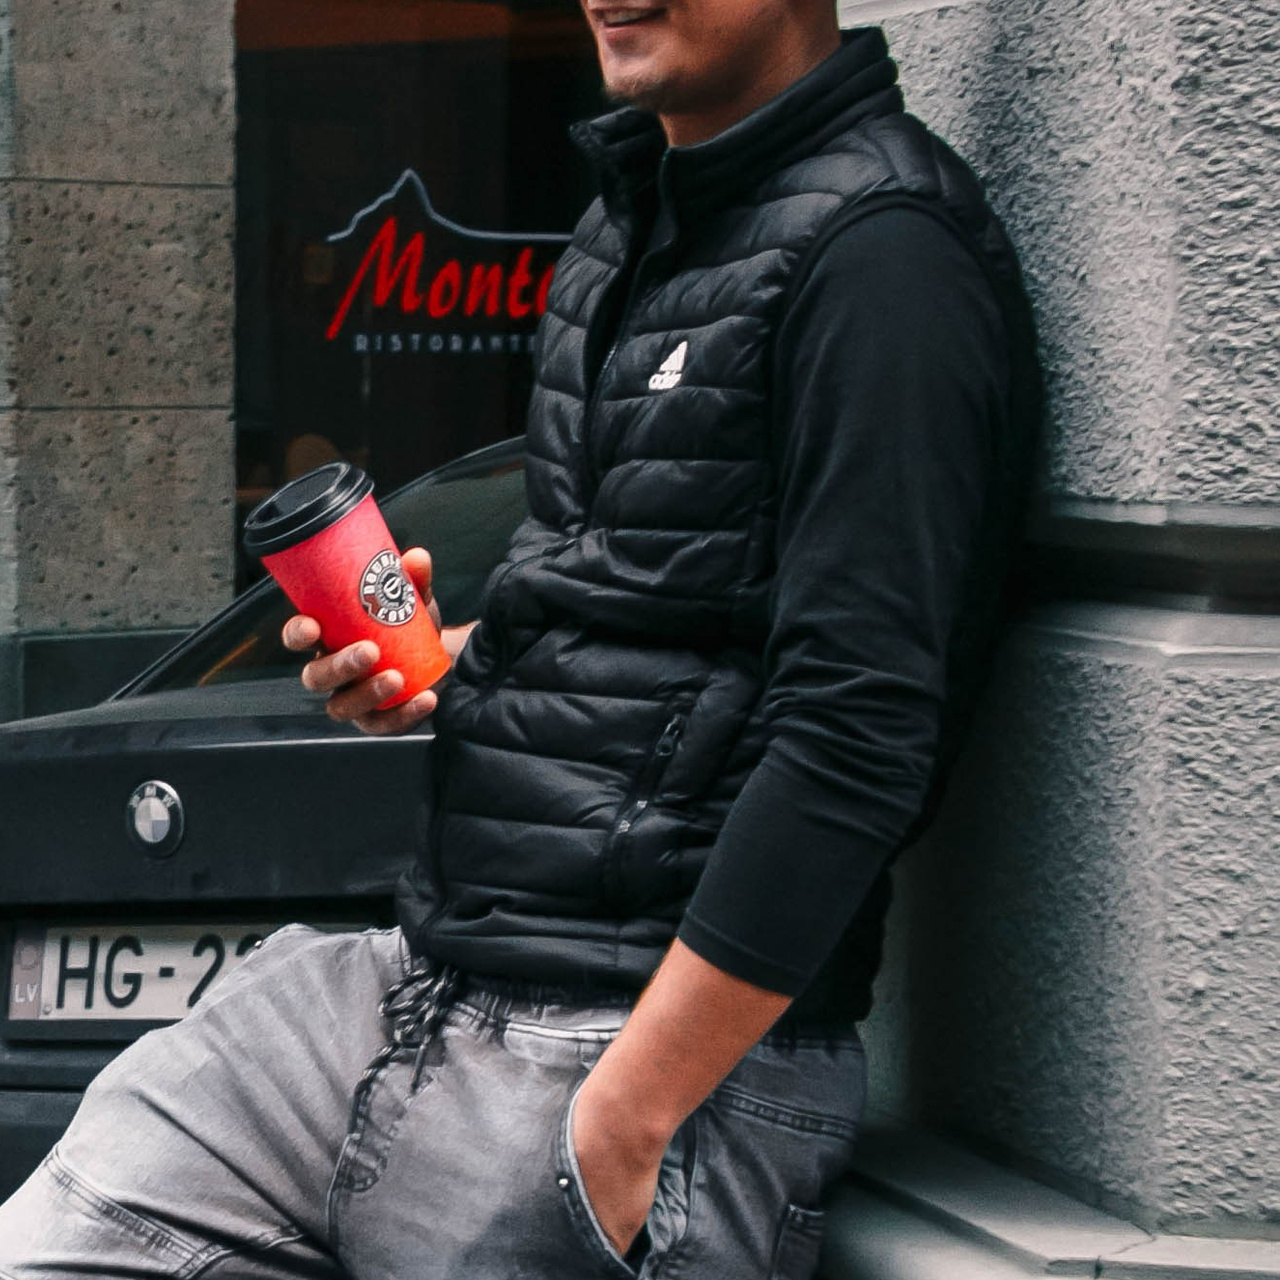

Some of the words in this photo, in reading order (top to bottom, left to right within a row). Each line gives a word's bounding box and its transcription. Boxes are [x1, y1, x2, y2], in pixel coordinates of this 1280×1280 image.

[129, 784, 176, 809] BMW
[15, 984, 39, 1003] LV
[56, 933, 264, 1010] HG-2
